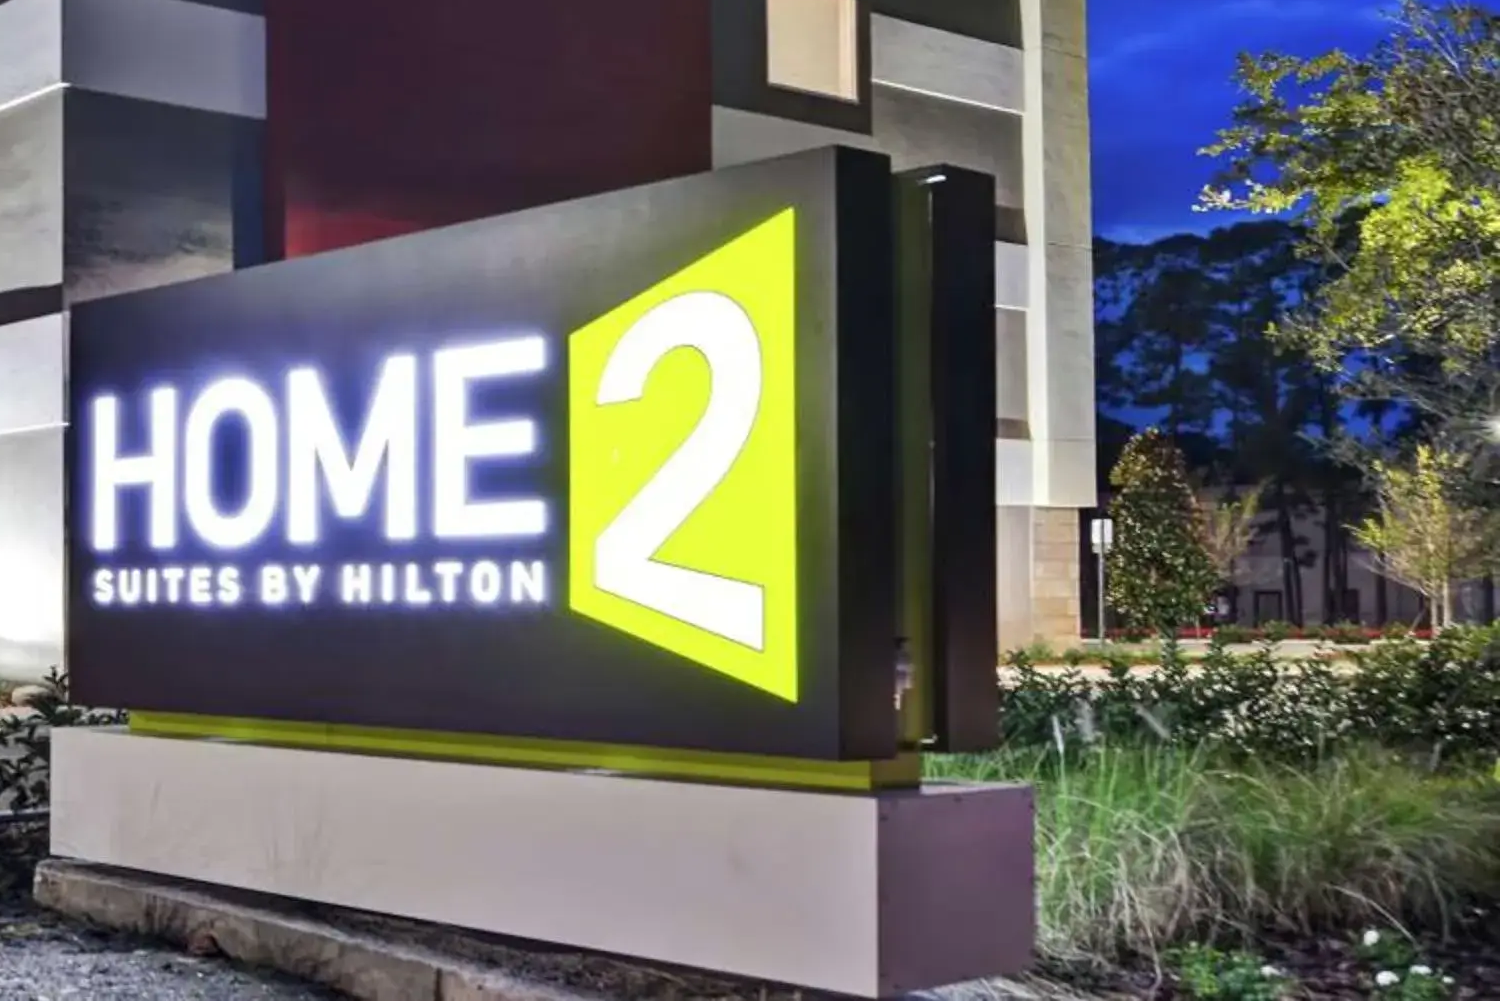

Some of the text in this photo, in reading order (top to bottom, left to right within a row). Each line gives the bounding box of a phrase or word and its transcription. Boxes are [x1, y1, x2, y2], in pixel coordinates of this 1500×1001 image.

[93, 558, 546, 605] SUITES BY HILTON
